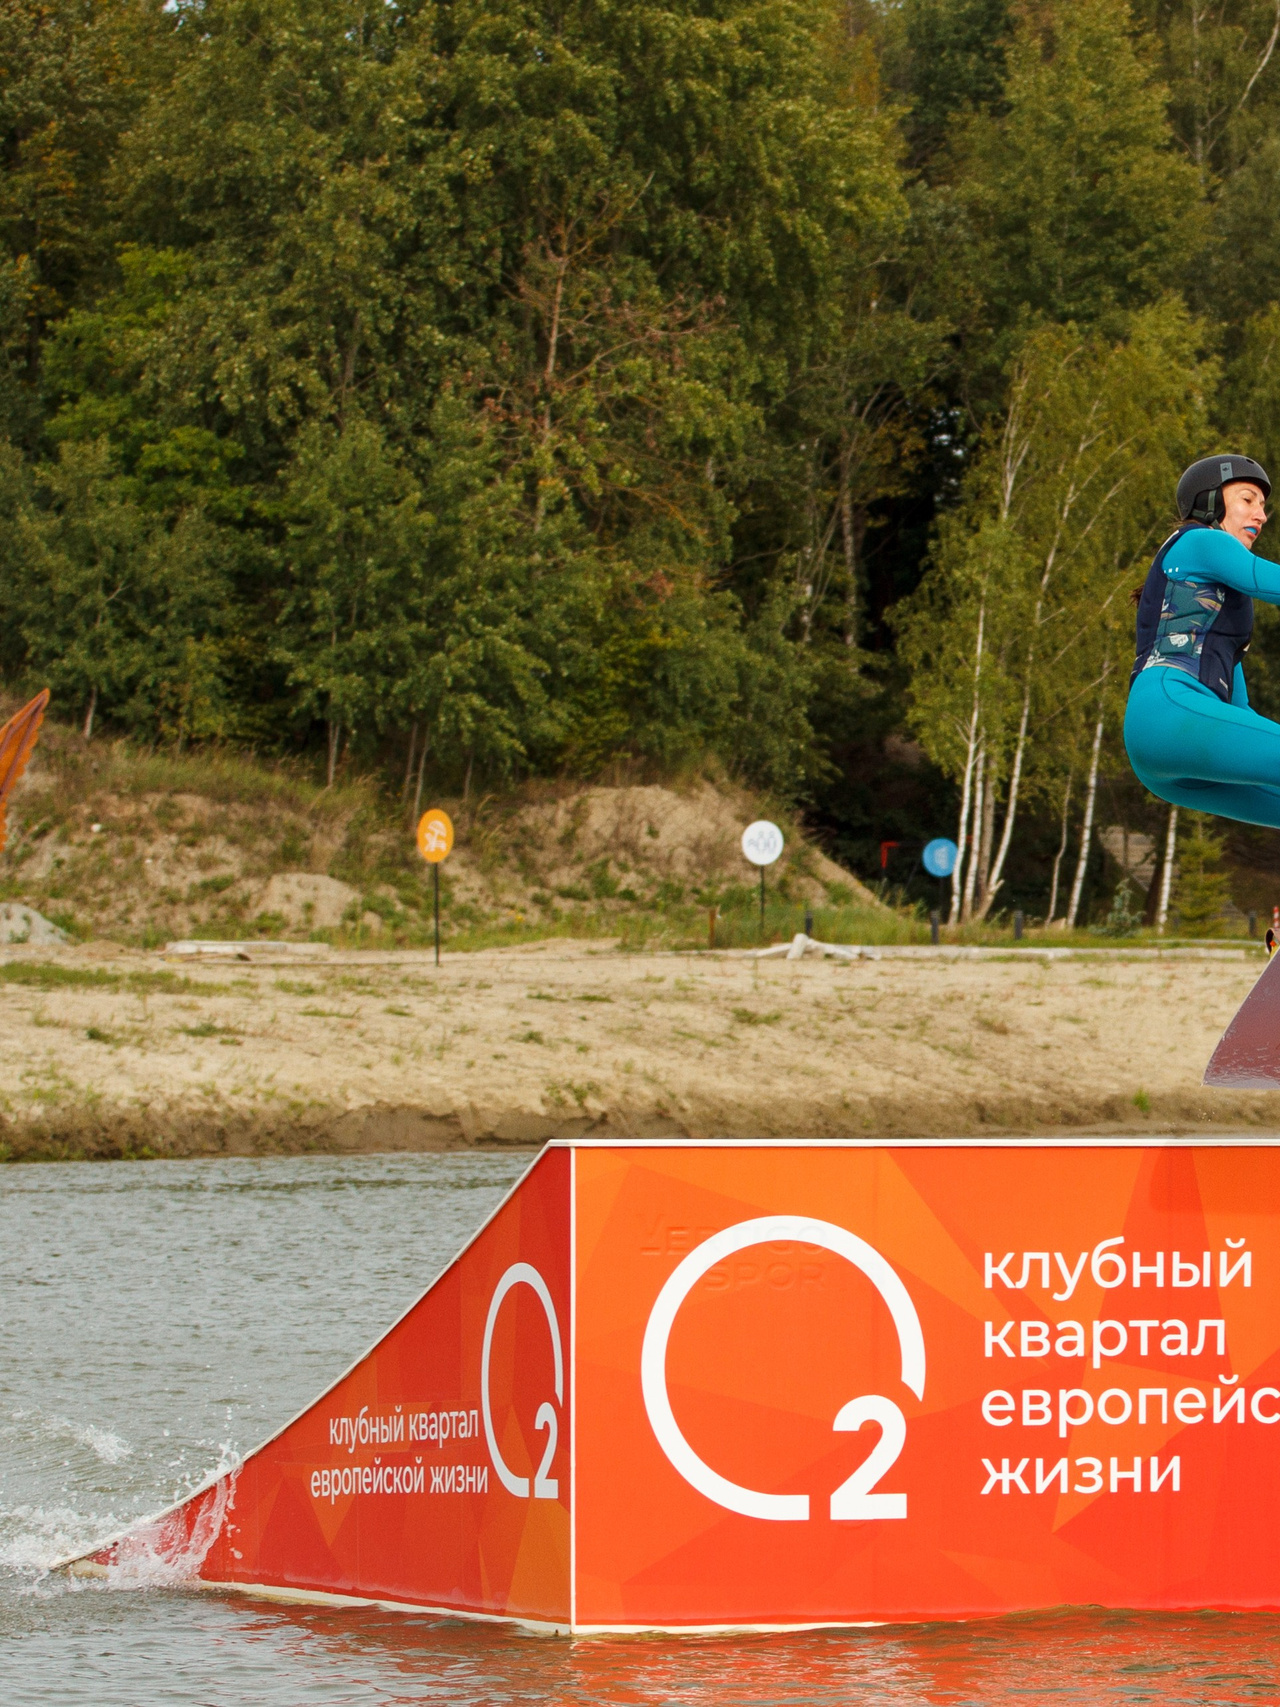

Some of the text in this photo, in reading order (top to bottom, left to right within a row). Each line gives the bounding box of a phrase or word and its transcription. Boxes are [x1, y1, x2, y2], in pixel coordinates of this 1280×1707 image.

[985, 1236, 1252, 1302] клубный
[985, 1318, 1226, 1369] квартал
[329, 1405, 479, 1454] клубный квартал
[310, 1456, 488, 1505] европейской жизни
[981, 1456, 1181, 1495] жизни
